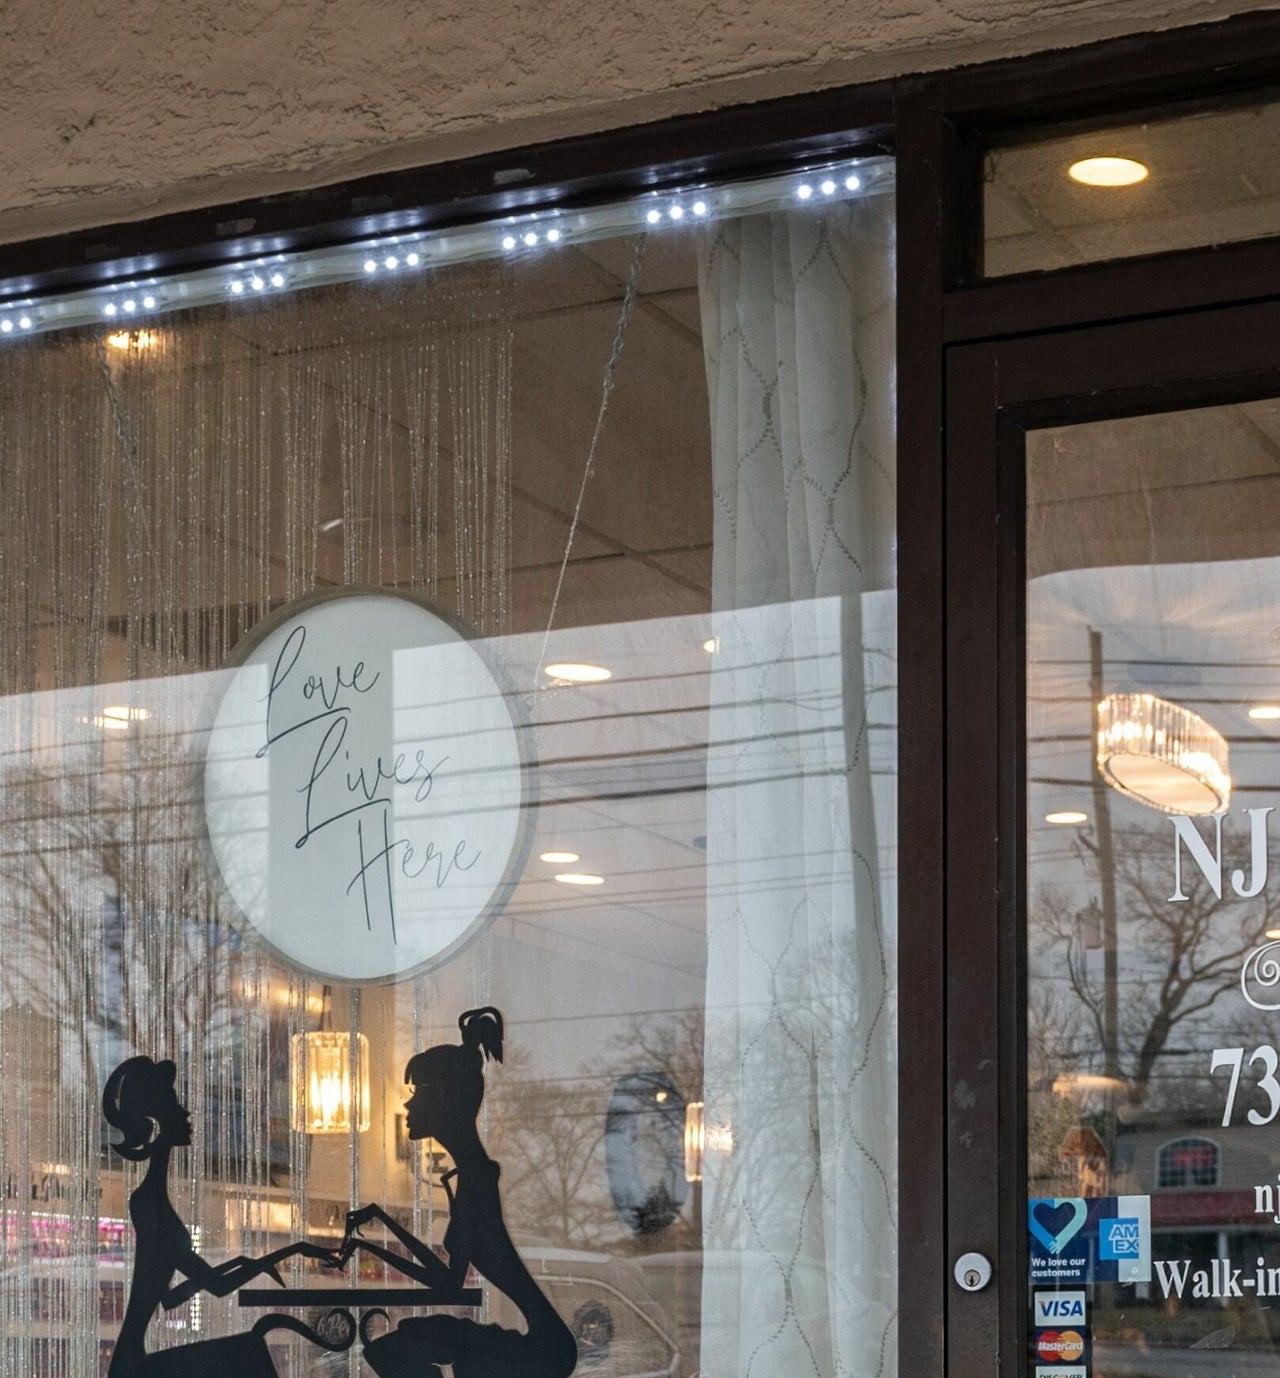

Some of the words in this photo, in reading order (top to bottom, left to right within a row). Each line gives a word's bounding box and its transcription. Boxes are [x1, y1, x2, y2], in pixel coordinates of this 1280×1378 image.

[255, 625, 381, 759] Love
[295, 715, 451, 849] Lives
[346, 808, 483, 946] Here
[1166, 806, 1275, 903] NJ
[1031, 1258, 1047, 1267] We
[1048, 1258, 1068, 1266] love
[1069, 1258, 1086, 1266] our
[1031, 1269, 1081, 1277] customers
[1040, 1300, 1084, 1317] VISA
[1038, 1341, 1083, 1352] MasterCard
